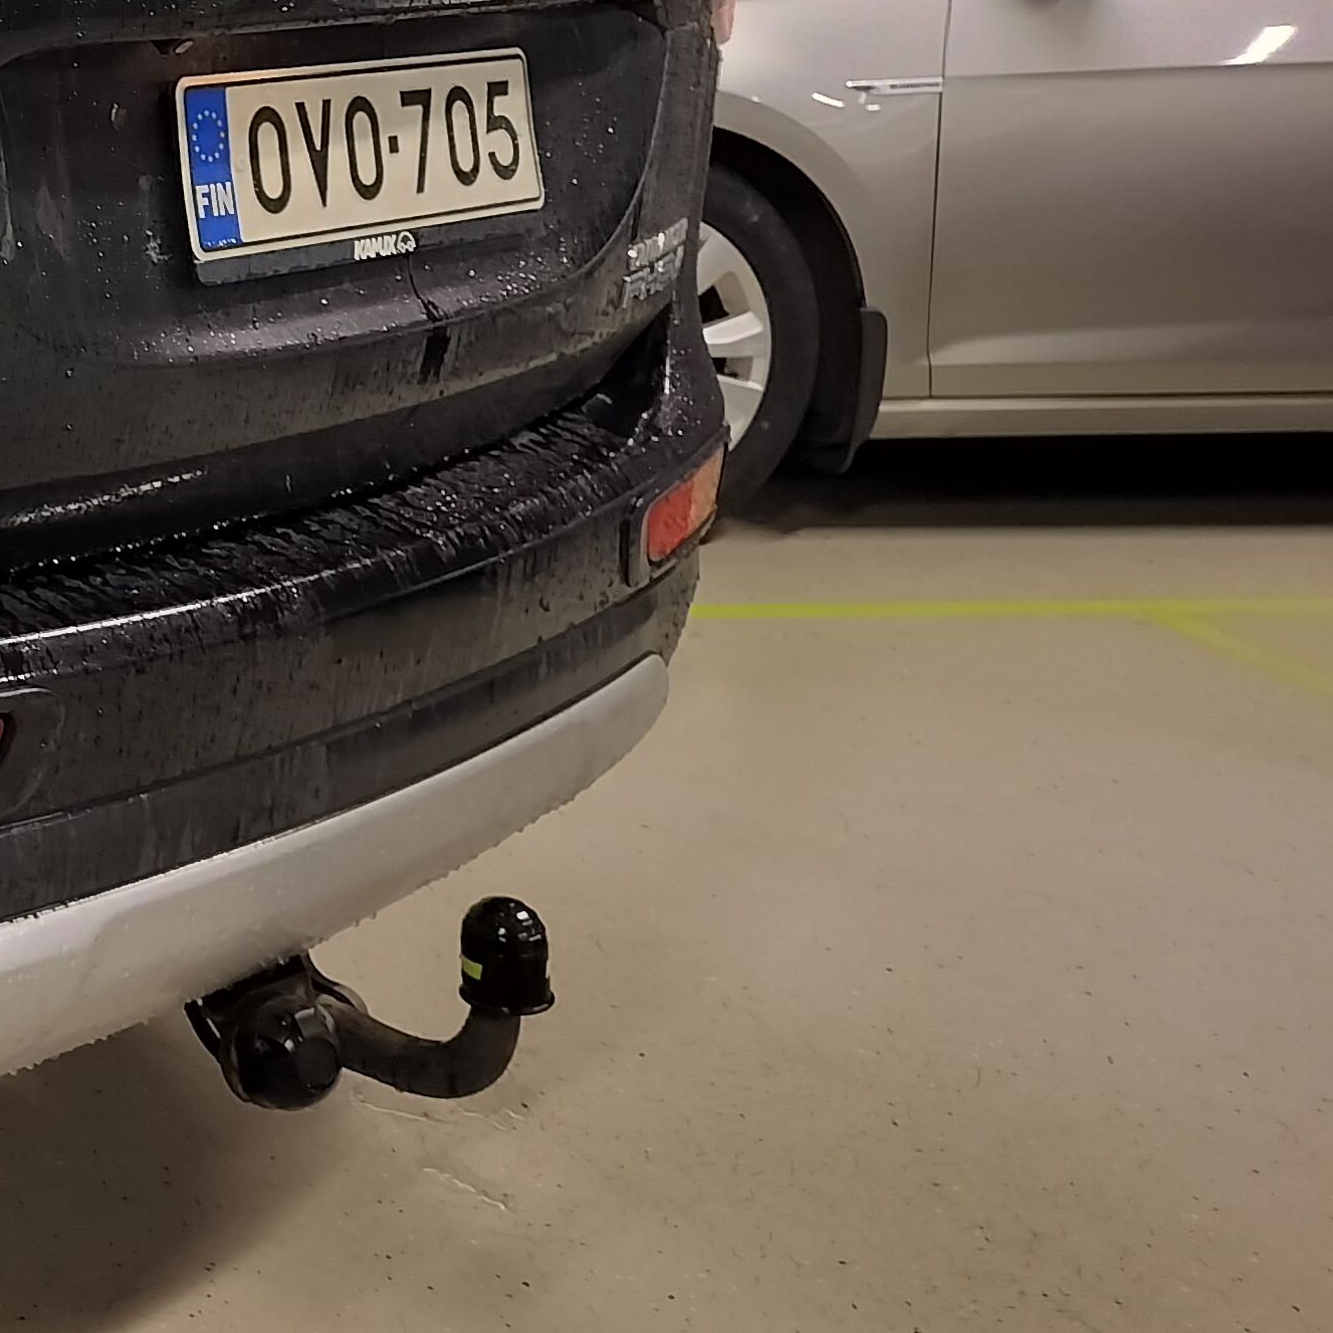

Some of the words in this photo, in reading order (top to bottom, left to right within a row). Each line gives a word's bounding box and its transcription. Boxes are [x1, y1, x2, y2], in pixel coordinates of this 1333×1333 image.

[247, 80, 520, 215] OVO-705
[195, 181, 235, 219] FIN
[353, 234, 398, 261] KAMUX
